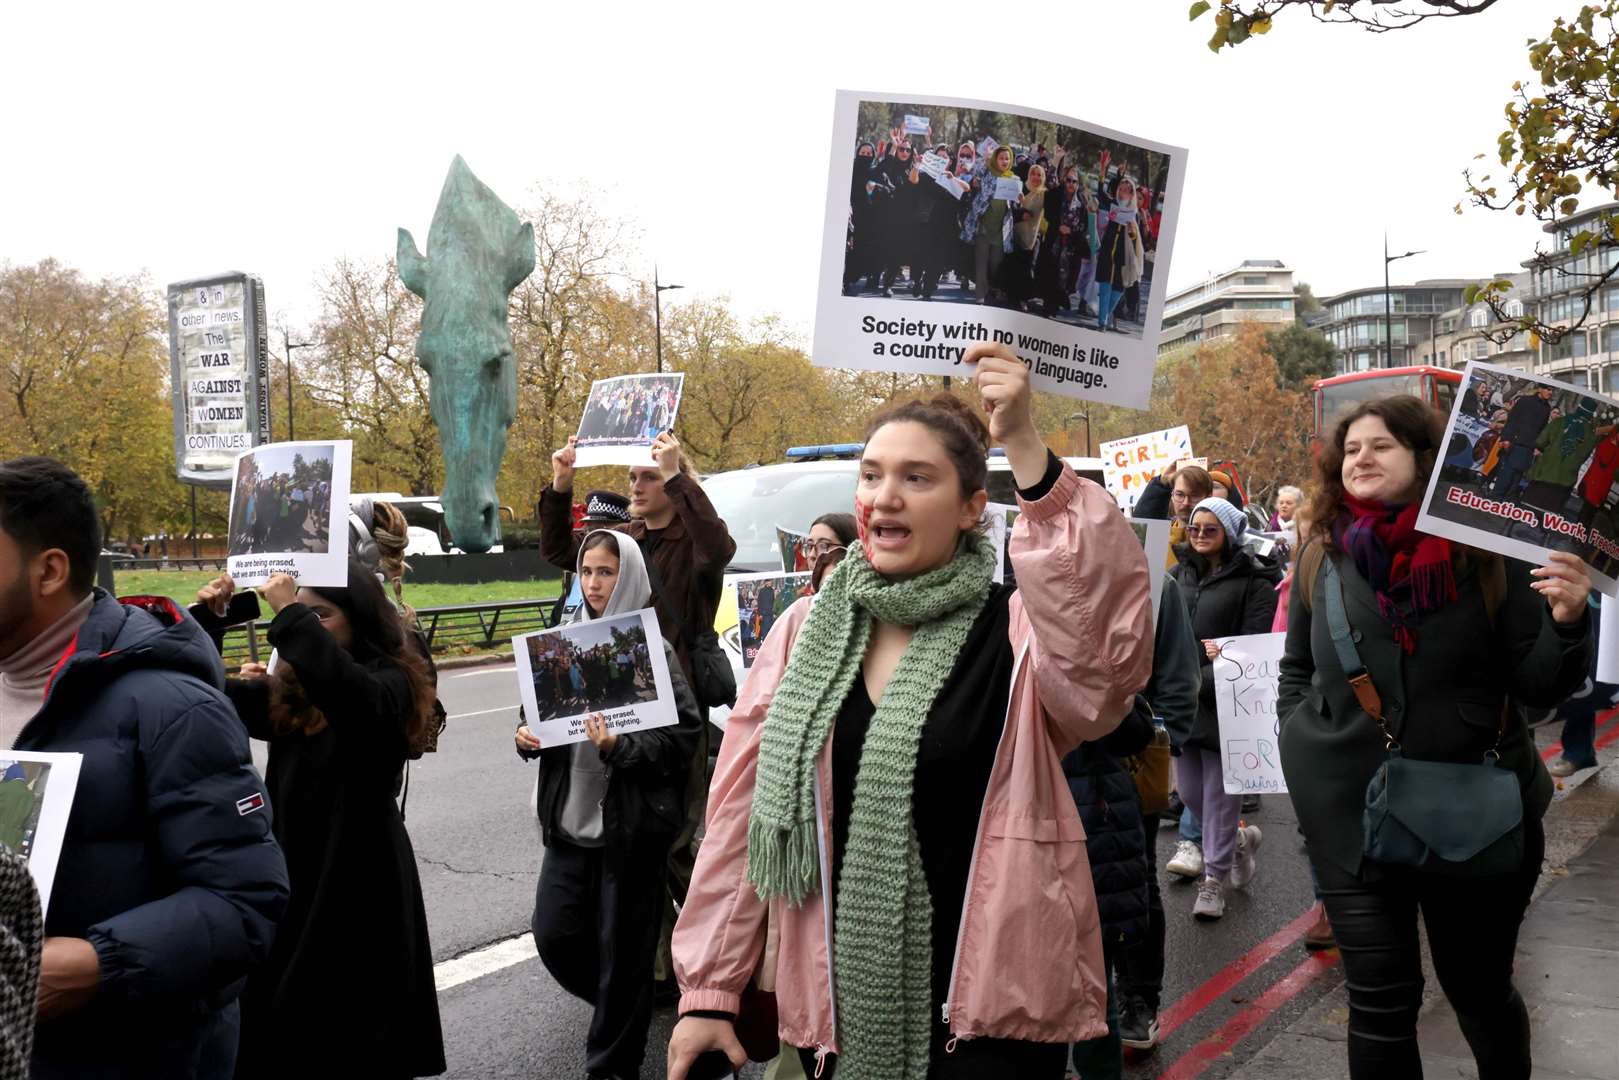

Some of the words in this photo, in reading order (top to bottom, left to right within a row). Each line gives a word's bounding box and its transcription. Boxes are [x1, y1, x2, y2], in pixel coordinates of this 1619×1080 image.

[200, 291, 206, 304] &
[215, 291, 222, 303] in
[181, 313, 206, 326] other
[205, 333, 224, 345] The
[862, 316, 937, 341] Society
[943, 322, 988, 341] with
[993, 329, 1013, 345] no
[1018, 334, 1070, 360] women
[1073, 344, 1086, 362] is
[1090, 348, 1119, 369] like
[200, 353, 230, 367] WAR
[259, 337, 267, 378] WOMEN
[873, 341, 885, 355] a
[890, 343, 966, 365] country
[1035, 357, 1107, 389] language.
[192, 380, 241, 394] AGAINST
[198, 407, 243, 421] WOMEN
[259, 384, 268, 433] AGAINST
[1115, 443, 1169, 467] GIRL
[1448, 488, 1538, 527] Education,
[1543, 512, 1587, 543] Work,
